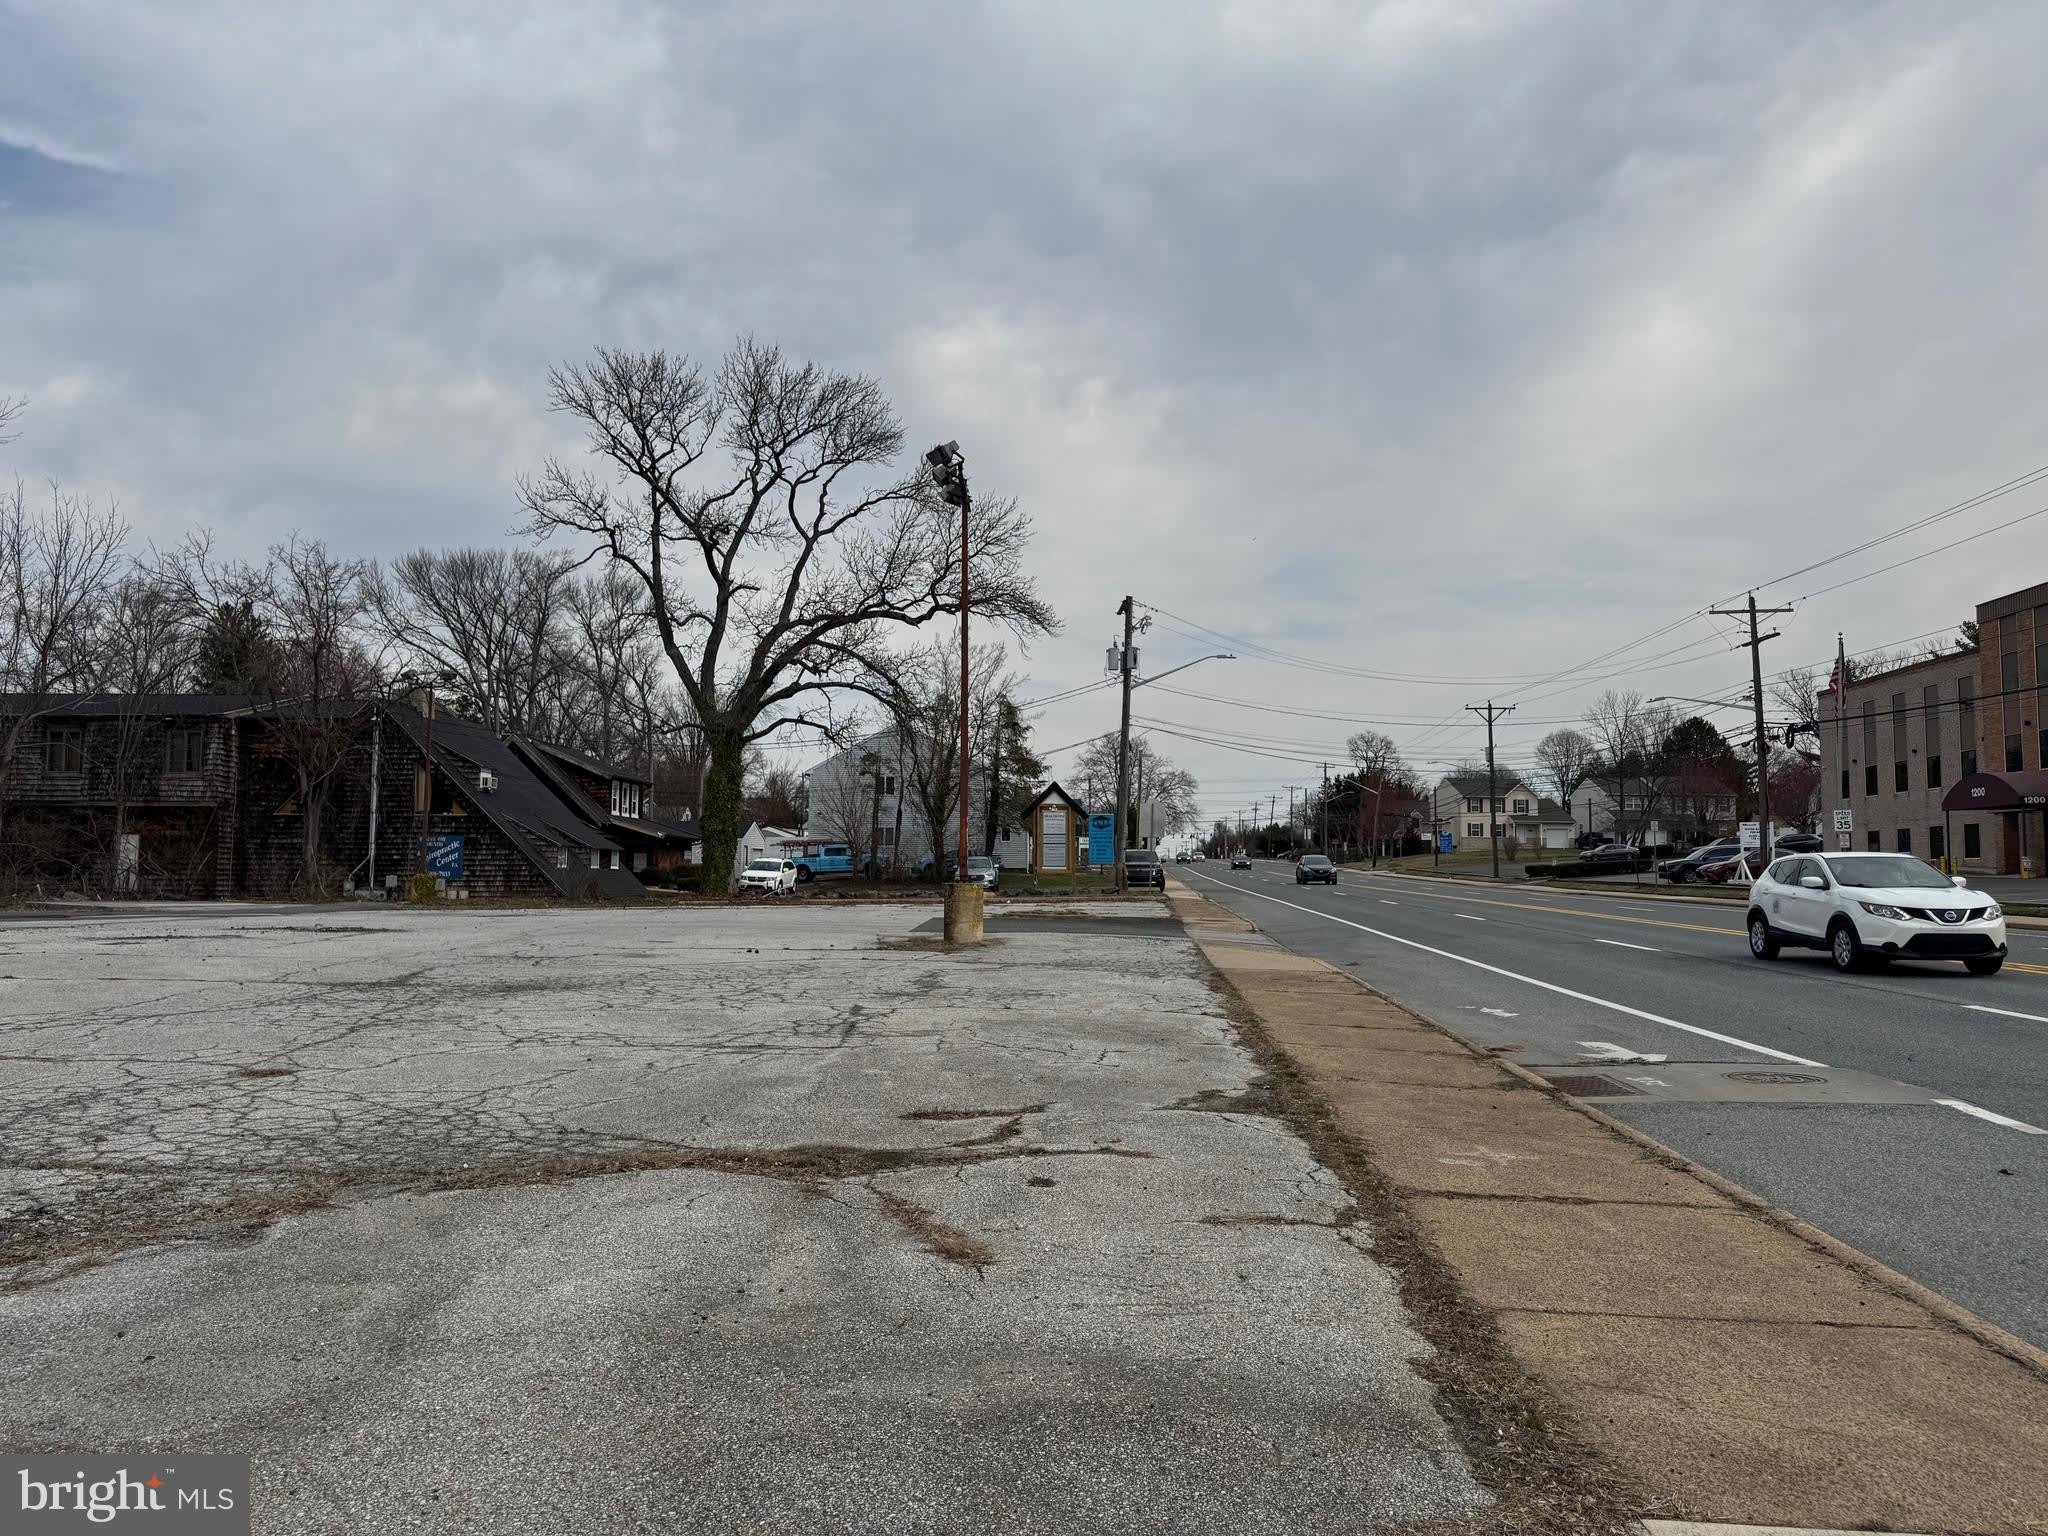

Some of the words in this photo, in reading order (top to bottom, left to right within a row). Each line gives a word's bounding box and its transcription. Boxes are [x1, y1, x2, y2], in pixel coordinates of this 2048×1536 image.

[1971, 787, 1985, 797] 1200
[2024, 796, 2046, 804] 1200
[1836, 820, 1851, 830] 35
[425, 840, 461, 861] iropractic
[436, 852, 459, 867] Center
